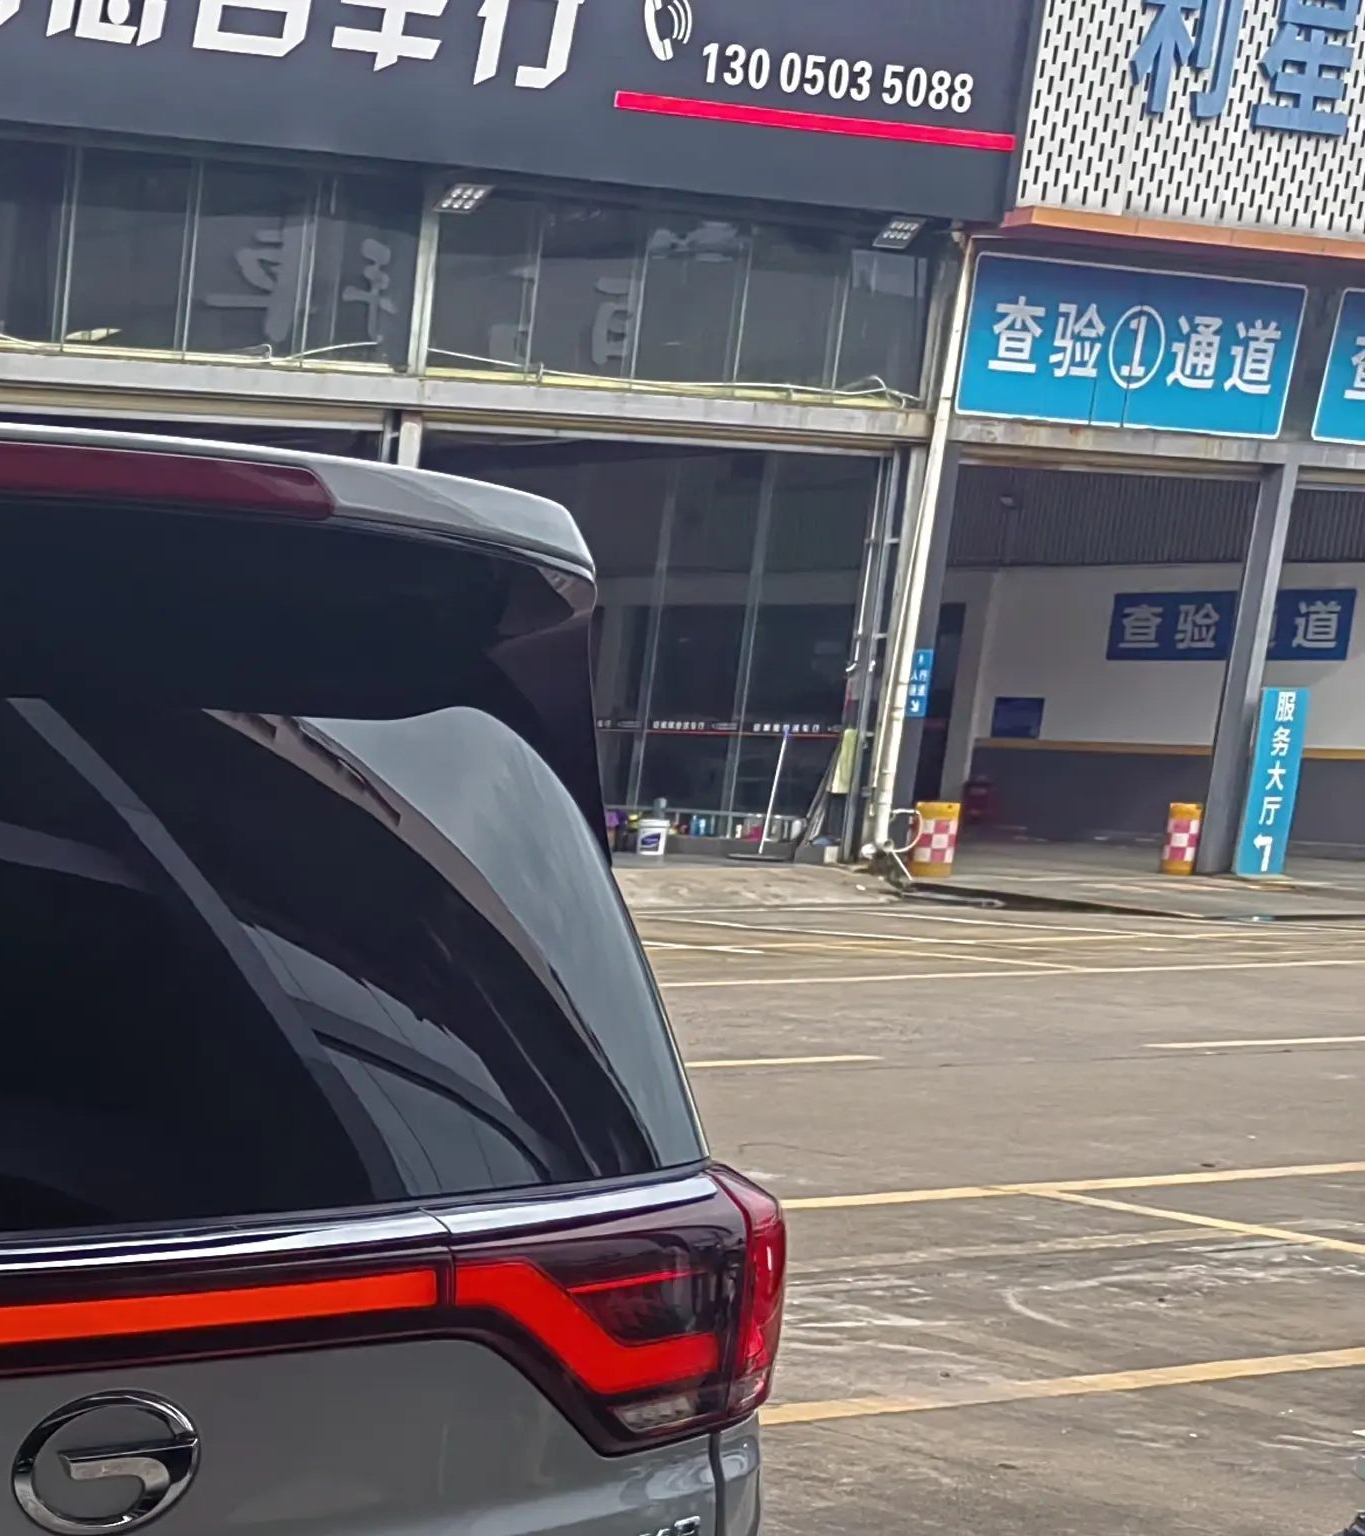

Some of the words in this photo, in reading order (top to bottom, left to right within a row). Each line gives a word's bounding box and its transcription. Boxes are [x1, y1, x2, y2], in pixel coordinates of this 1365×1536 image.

[702, 43, 770, 90] 130
[779, 52, 872, 102] 0503
[881, 64, 974, 113] 5088
[1119, 603, 1342, 649] 查验道
[1258, 691, 1296, 825] 服务大厅
